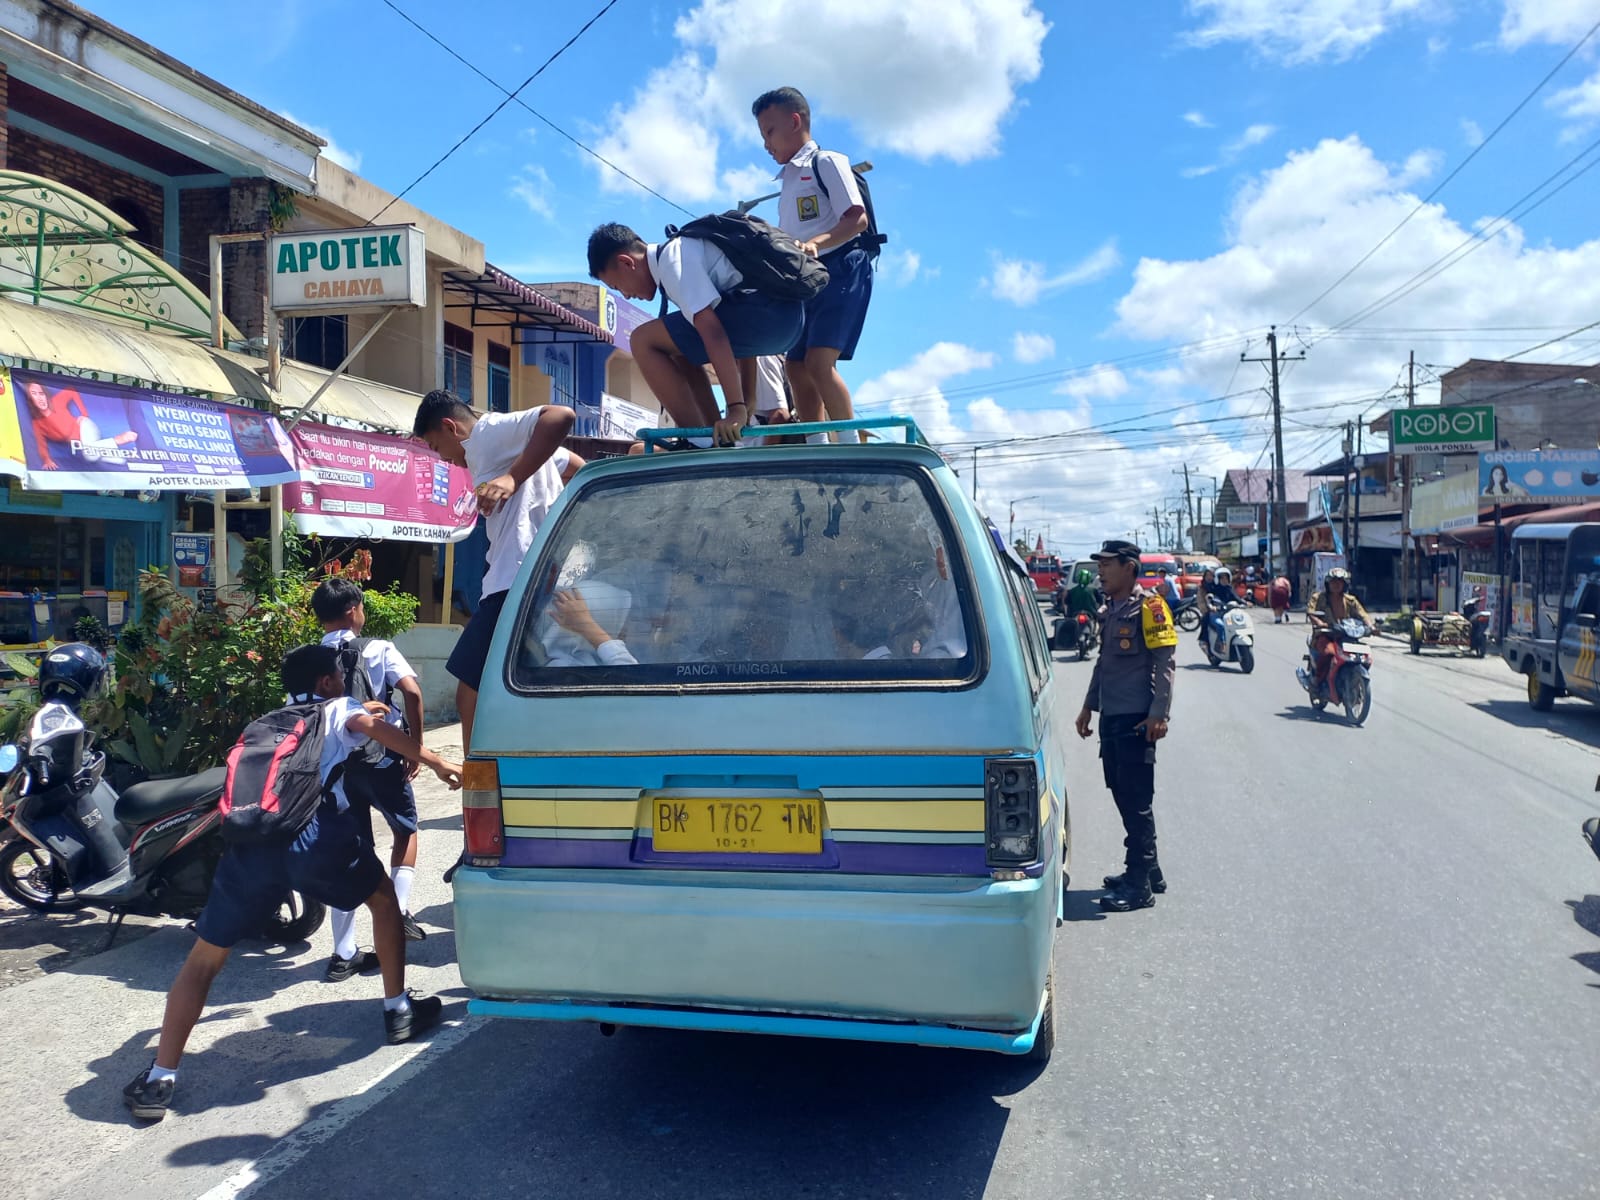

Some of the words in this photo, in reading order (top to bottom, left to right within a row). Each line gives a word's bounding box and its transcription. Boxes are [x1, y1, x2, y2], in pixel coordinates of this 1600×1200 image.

[277, 234, 402, 274] APOTEK
[304, 278, 384, 299] CAHAYA
[153, 405, 191, 421] NYERI
[192, 411, 222, 426] OTOT
[1400, 411, 1487, 437] ROBOT
[157, 421, 193, 437] NYERI
[194, 426, 231, 441] SENDI
[299, 430, 318, 442] Saat
[163, 436, 204, 452] PEGAL
[205, 441, 236, 454] LINU?
[1442, 443, 1475, 451] PONSEL
[140, 449, 169, 461] NYERI
[336, 452, 366, 467] dengan
[369, 454, 408, 474] Procold
[1484, 452, 1537, 463] GROSIR
[149, 476, 191, 486] APOTEK
[192, 477, 232, 487] CAHAYA
[392, 525, 423, 538] APOTEK
[423, 528, 451, 539] CAHAYA
[676, 664, 718, 676] PANCA
[725, 663, 787, 676] TUNGGAL
[659, 803, 687, 833] BK
[707, 803, 763, 833] 1762
[783, 803, 813, 834] TN
